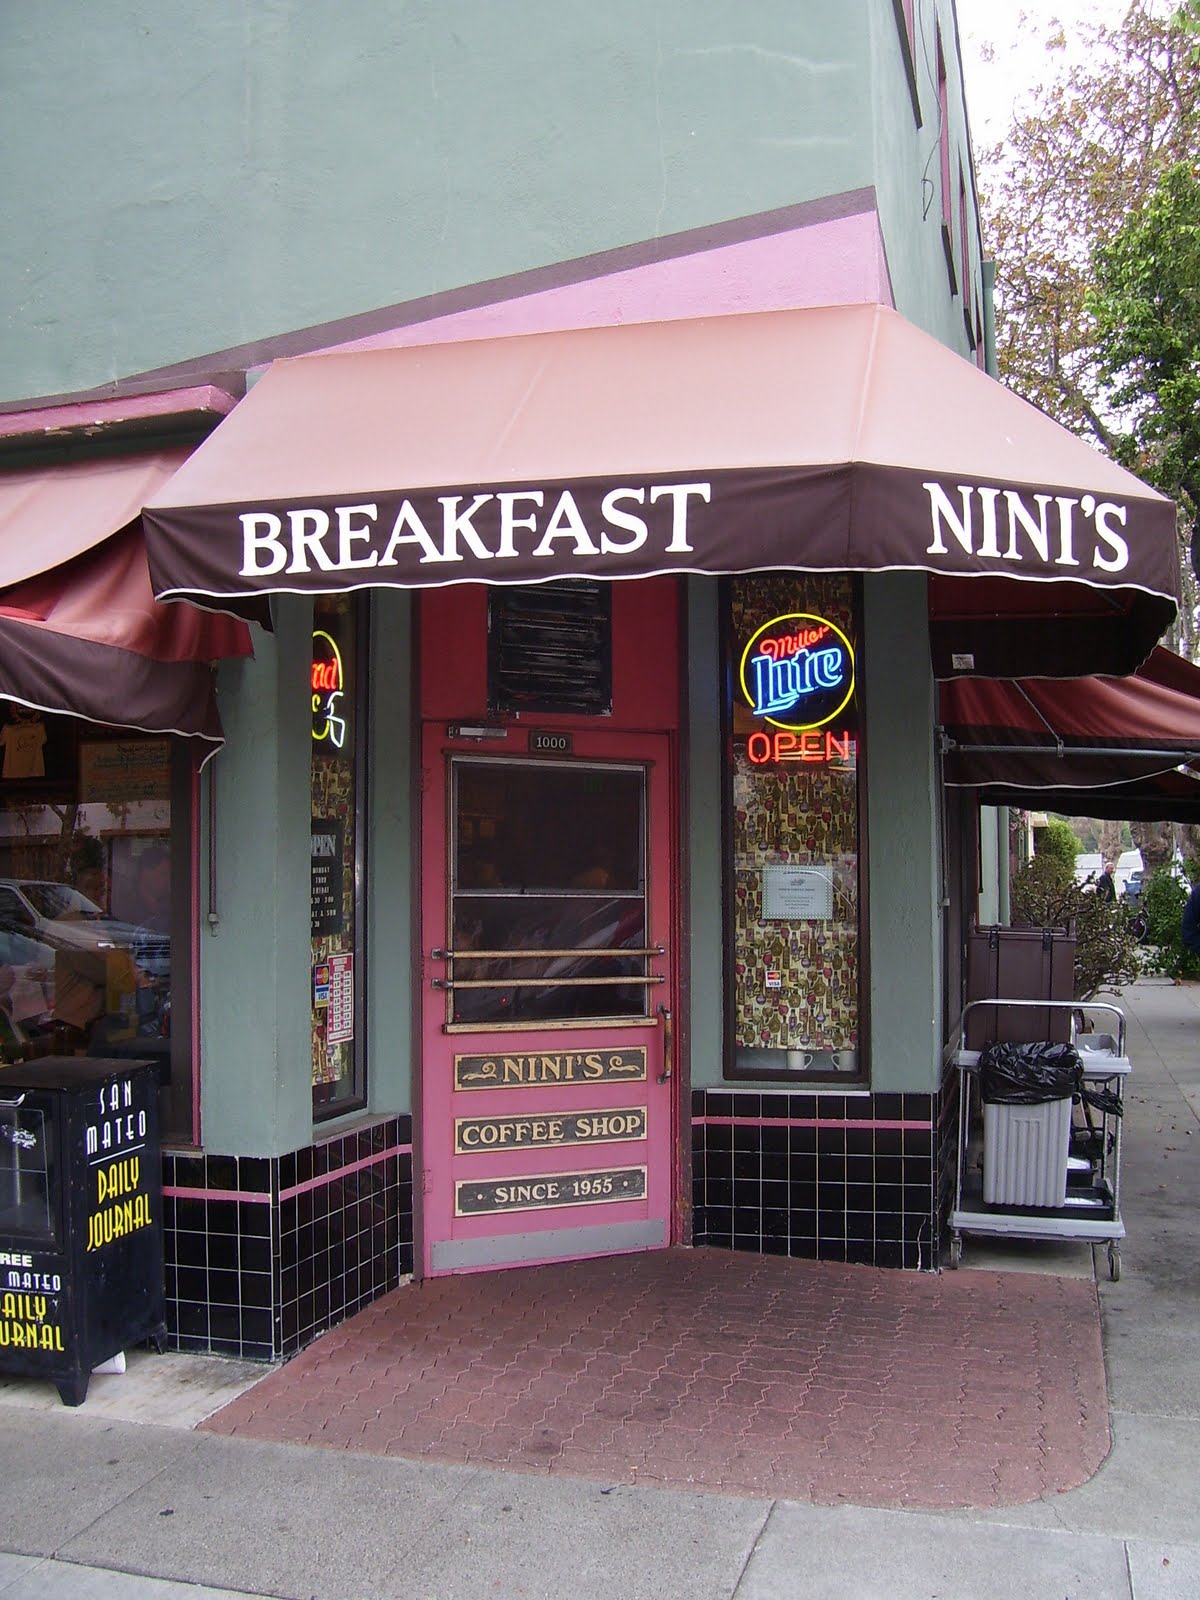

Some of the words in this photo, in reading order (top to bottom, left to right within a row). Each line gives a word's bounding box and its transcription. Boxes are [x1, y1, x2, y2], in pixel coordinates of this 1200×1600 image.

[238, 482, 711, 577] BREAKFAST
[922, 482, 1129, 573] NINI'S
[759, 626, 830, 661] Miller
[536, 736, 566, 749] 1000
[748, 730, 850, 763] OPEN
[311, 834, 336, 857] PEN
[318, 992, 328, 1001] VISA
[502, 1054, 604, 1082] NINI'S
[100, 1079, 132, 1115] SAN
[86, 1110, 146, 1155] MATEO
[462, 1121, 564, 1145] COFFEE
[575, 1115, 641, 1137] SHOP
[98, 1156, 140, 1204] DAILY
[494, 1182, 560, 1203] SINCE
[573, 1178, 613, 1196] 1955
[86, 1193, 152, 1252] JOURNAL
[0, 1252, 33, 1267] REE
[8, 1270, 61, 1291] MATEO
[0, 1292, 46, 1322] AILY
